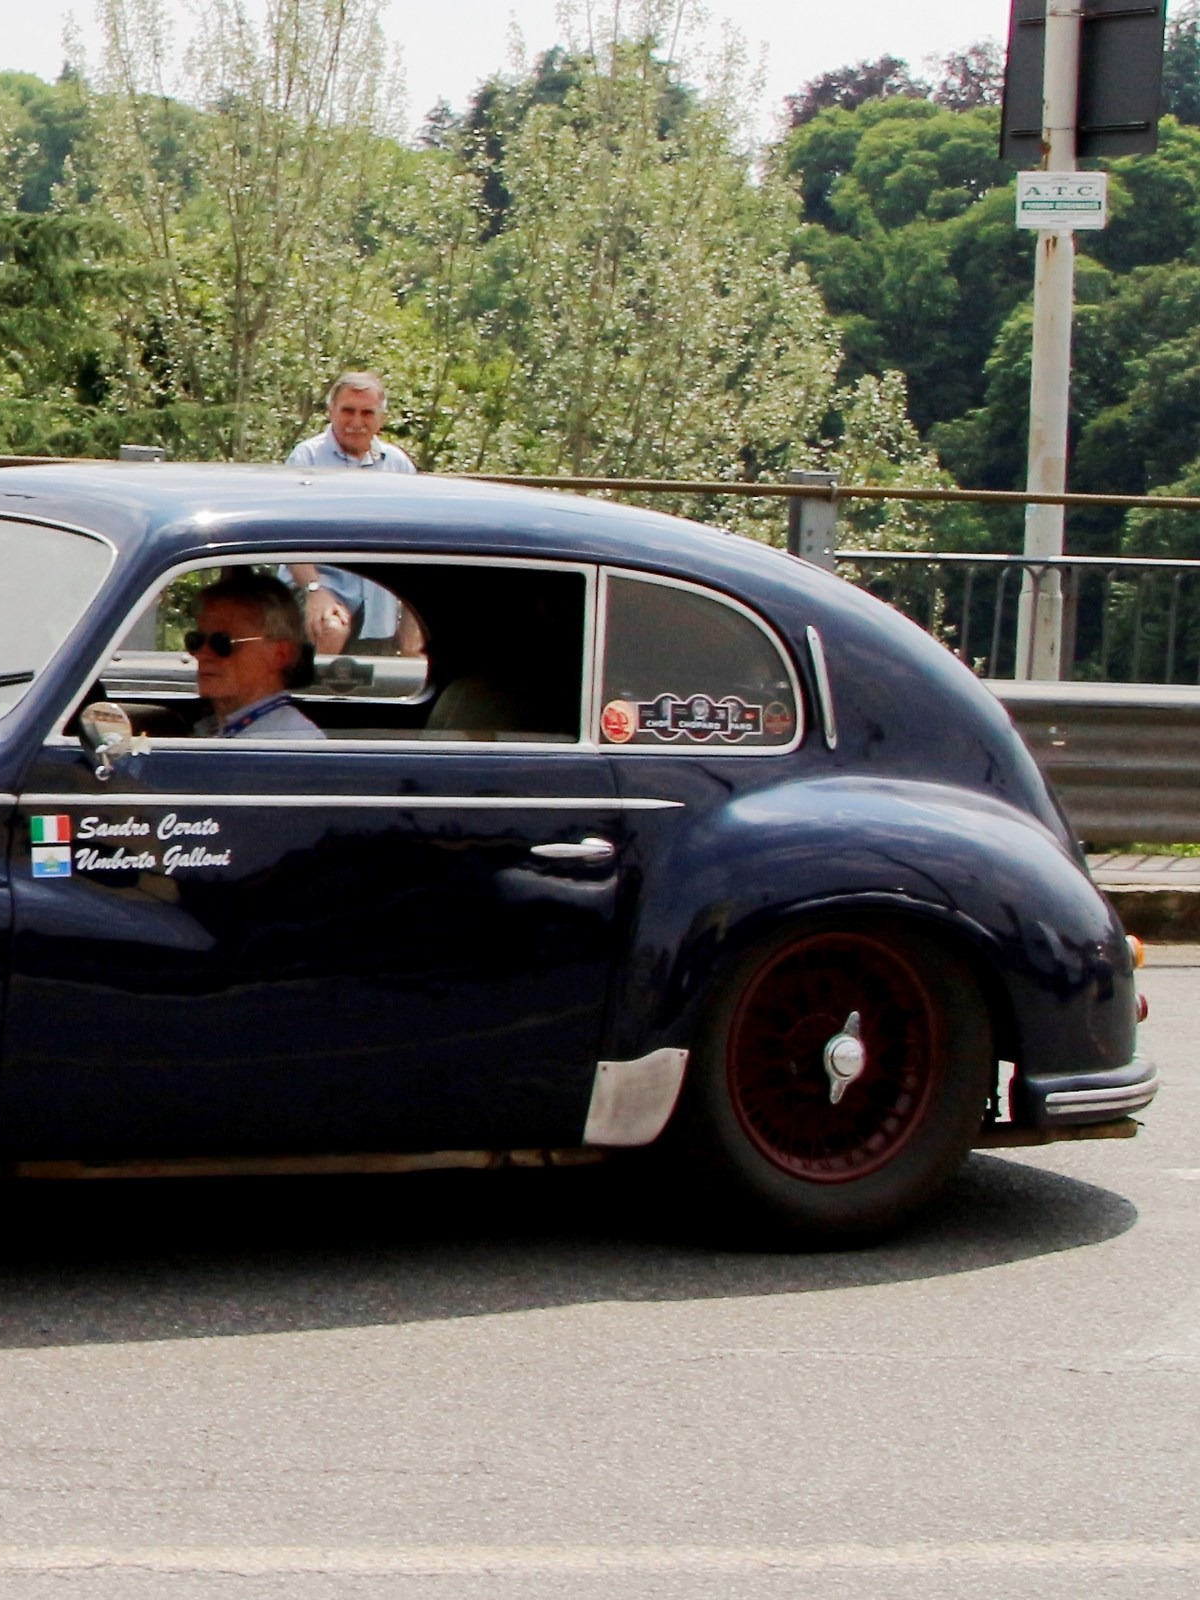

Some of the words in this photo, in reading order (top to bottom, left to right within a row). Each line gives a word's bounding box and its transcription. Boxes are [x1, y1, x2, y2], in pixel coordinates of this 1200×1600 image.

[1024, 186, 1100, 196] A.T.C.
[678, 719, 721, 730] CHOPARD
[76, 815, 150, 839] Sandro
[156, 813, 220, 840] Cerato
[74, 847, 157, 870] Umberto
[162, 845, 232, 875] Galloni
